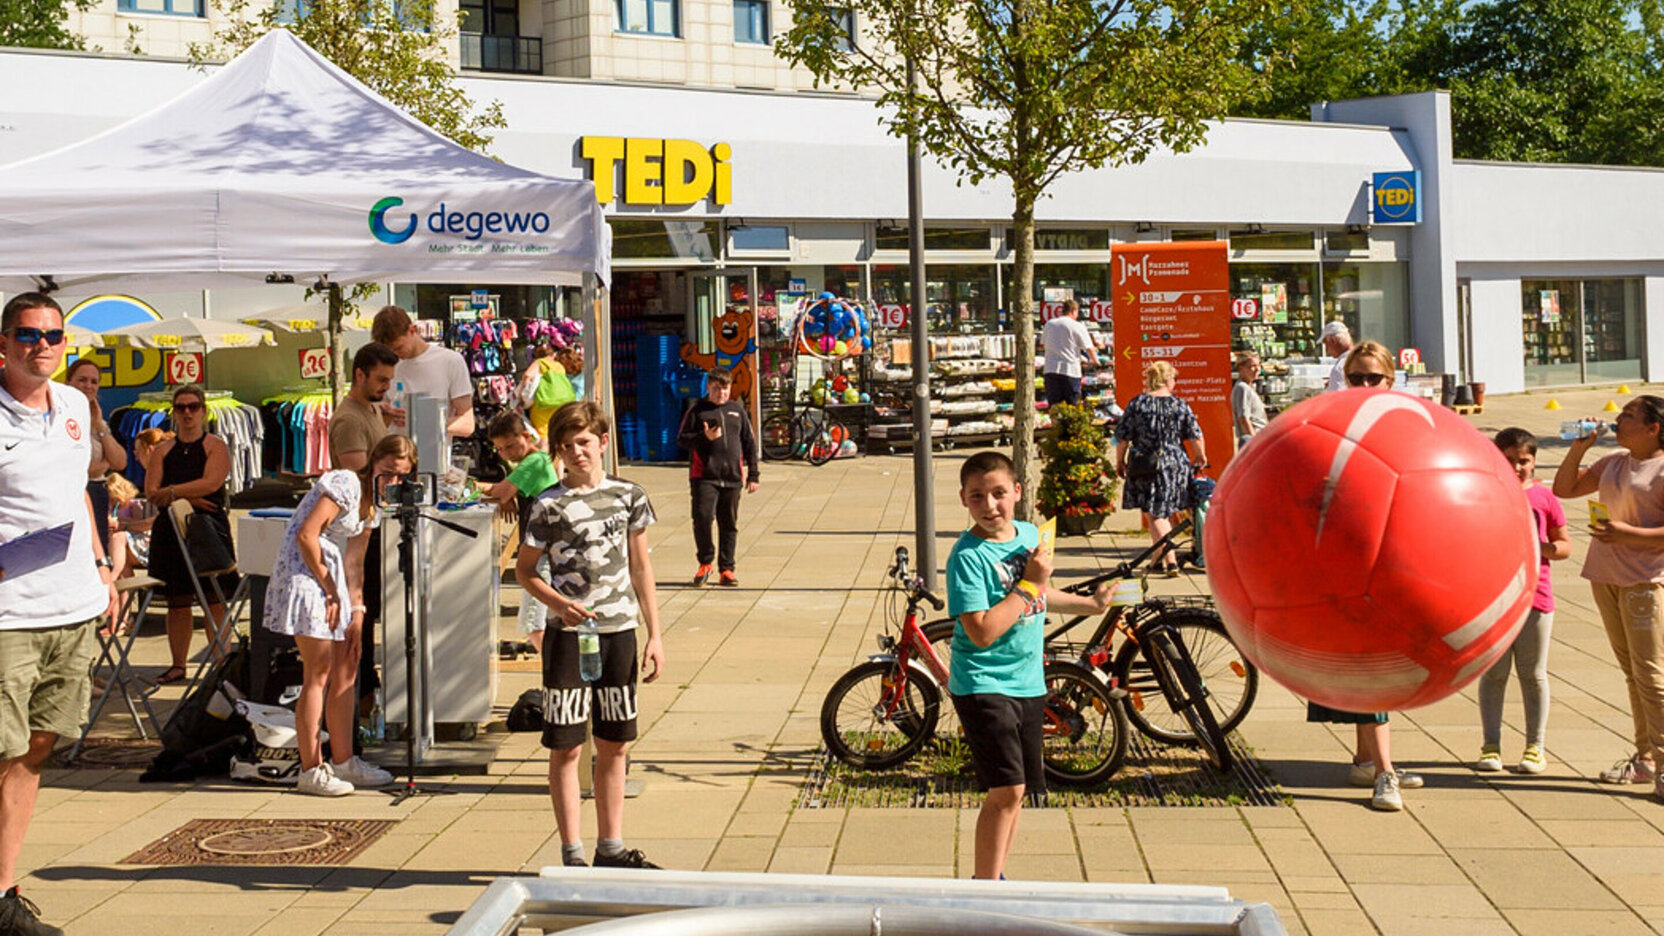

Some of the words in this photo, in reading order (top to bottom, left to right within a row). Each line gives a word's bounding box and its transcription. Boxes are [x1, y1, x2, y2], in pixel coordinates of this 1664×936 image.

[582, 136, 732, 205] TEDi
[1376, 188, 1414, 205] TEDi
[428, 203, 550, 240] degewo
[1142, 294, 1166, 302] 30-1
[881, 308, 900, 325] 1€
[1236, 301, 1252, 315] 1€
[175, 360, 196, 379] 2€
